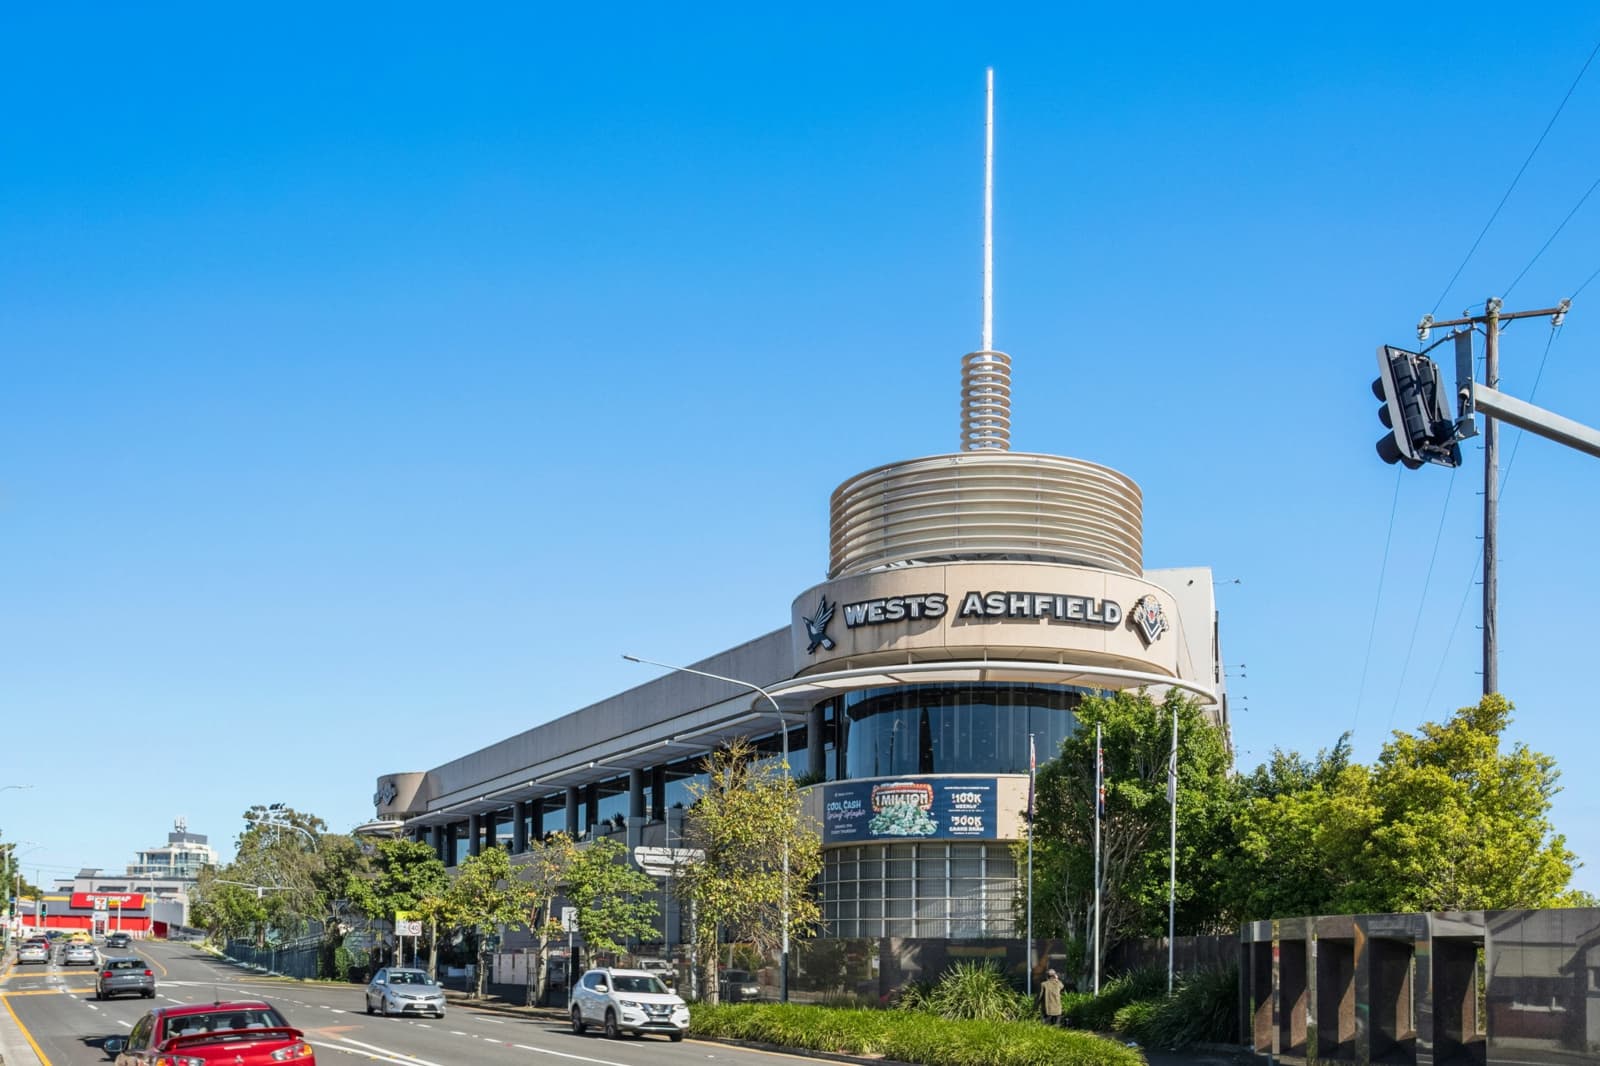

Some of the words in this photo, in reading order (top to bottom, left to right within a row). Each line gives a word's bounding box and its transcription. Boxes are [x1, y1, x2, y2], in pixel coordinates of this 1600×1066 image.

[844, 595, 947, 627] WESTS
[962, 592, 1122, 625] ASHFIELD
[843, 799, 862, 809] CASH
[881, 793, 928, 806] MILLION
